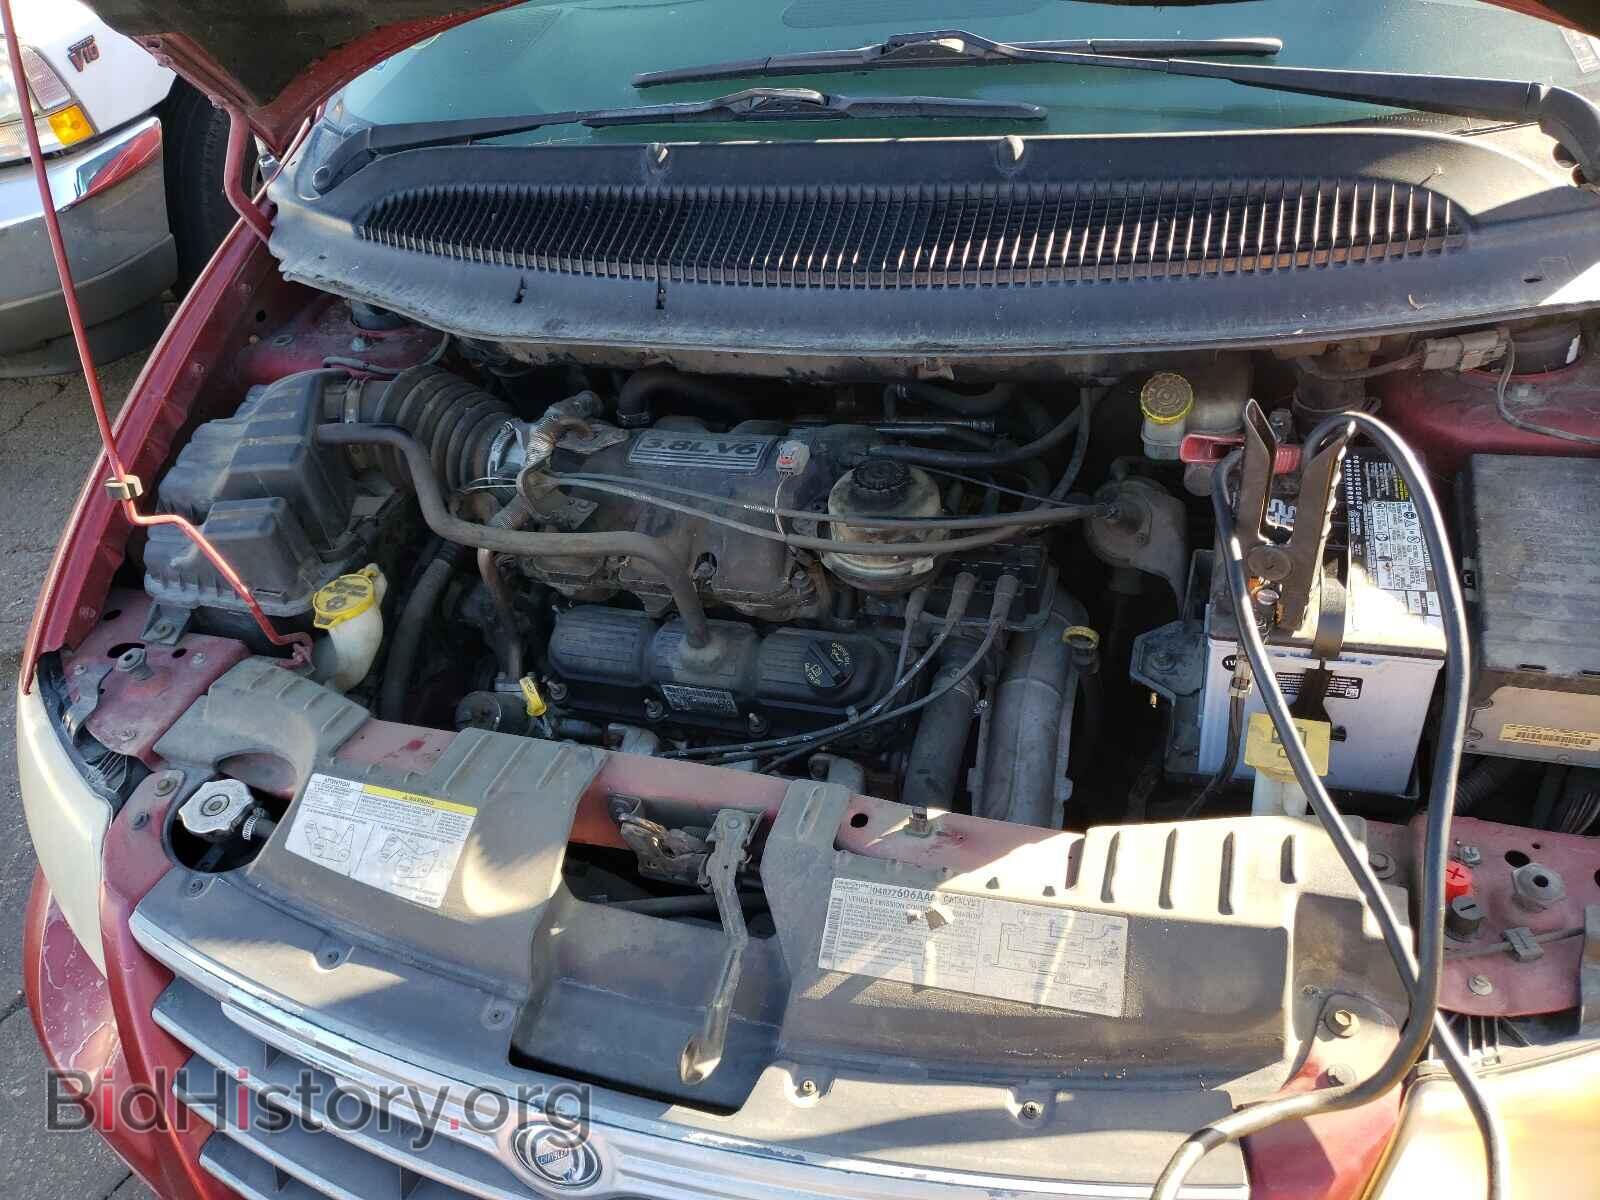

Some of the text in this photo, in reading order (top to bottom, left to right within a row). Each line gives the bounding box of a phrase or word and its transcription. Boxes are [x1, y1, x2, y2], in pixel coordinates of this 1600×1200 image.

[67, 42, 100, 72] V10
[641, 438, 758, 455] 3.8L V6
[538, 1150, 569, 1166] CHRYSLER
